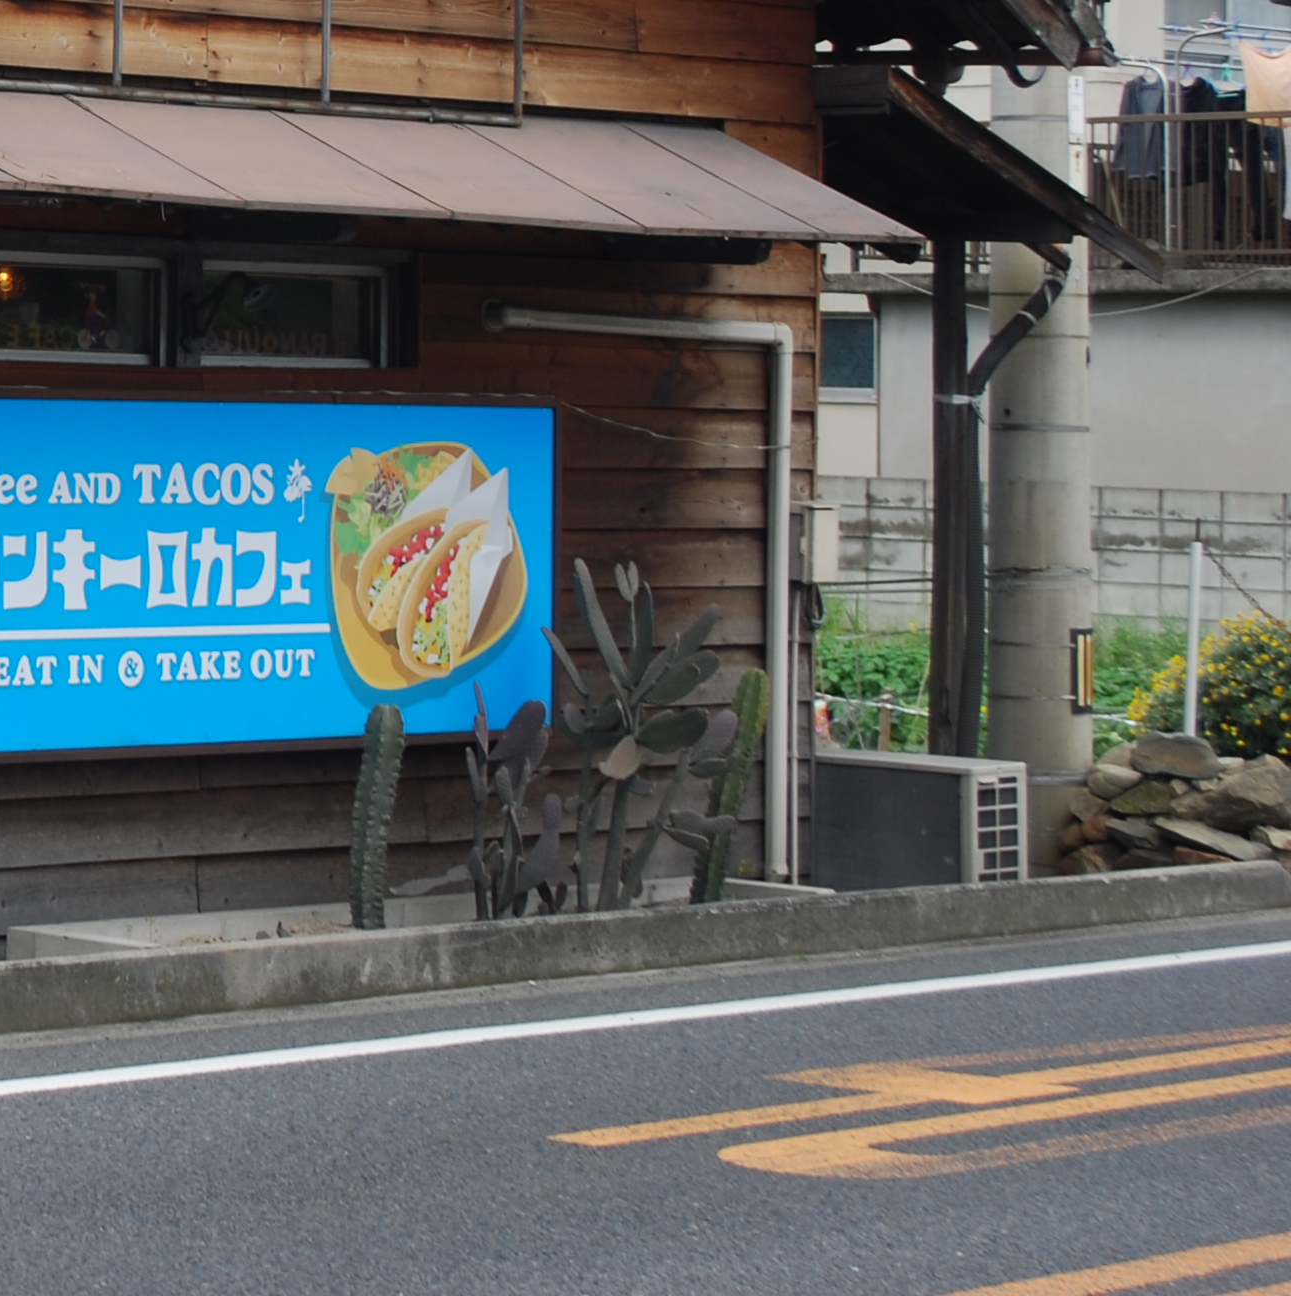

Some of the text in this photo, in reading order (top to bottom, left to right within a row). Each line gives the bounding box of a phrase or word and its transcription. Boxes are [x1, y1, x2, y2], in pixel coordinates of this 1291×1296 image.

[49, 471, 121, 505] AND
[133, 462, 274, 506] TACOS
[68, 654, 105, 686] IN
[156, 651, 242, 683] TAKE
[251, 649, 316, 680] OUT
